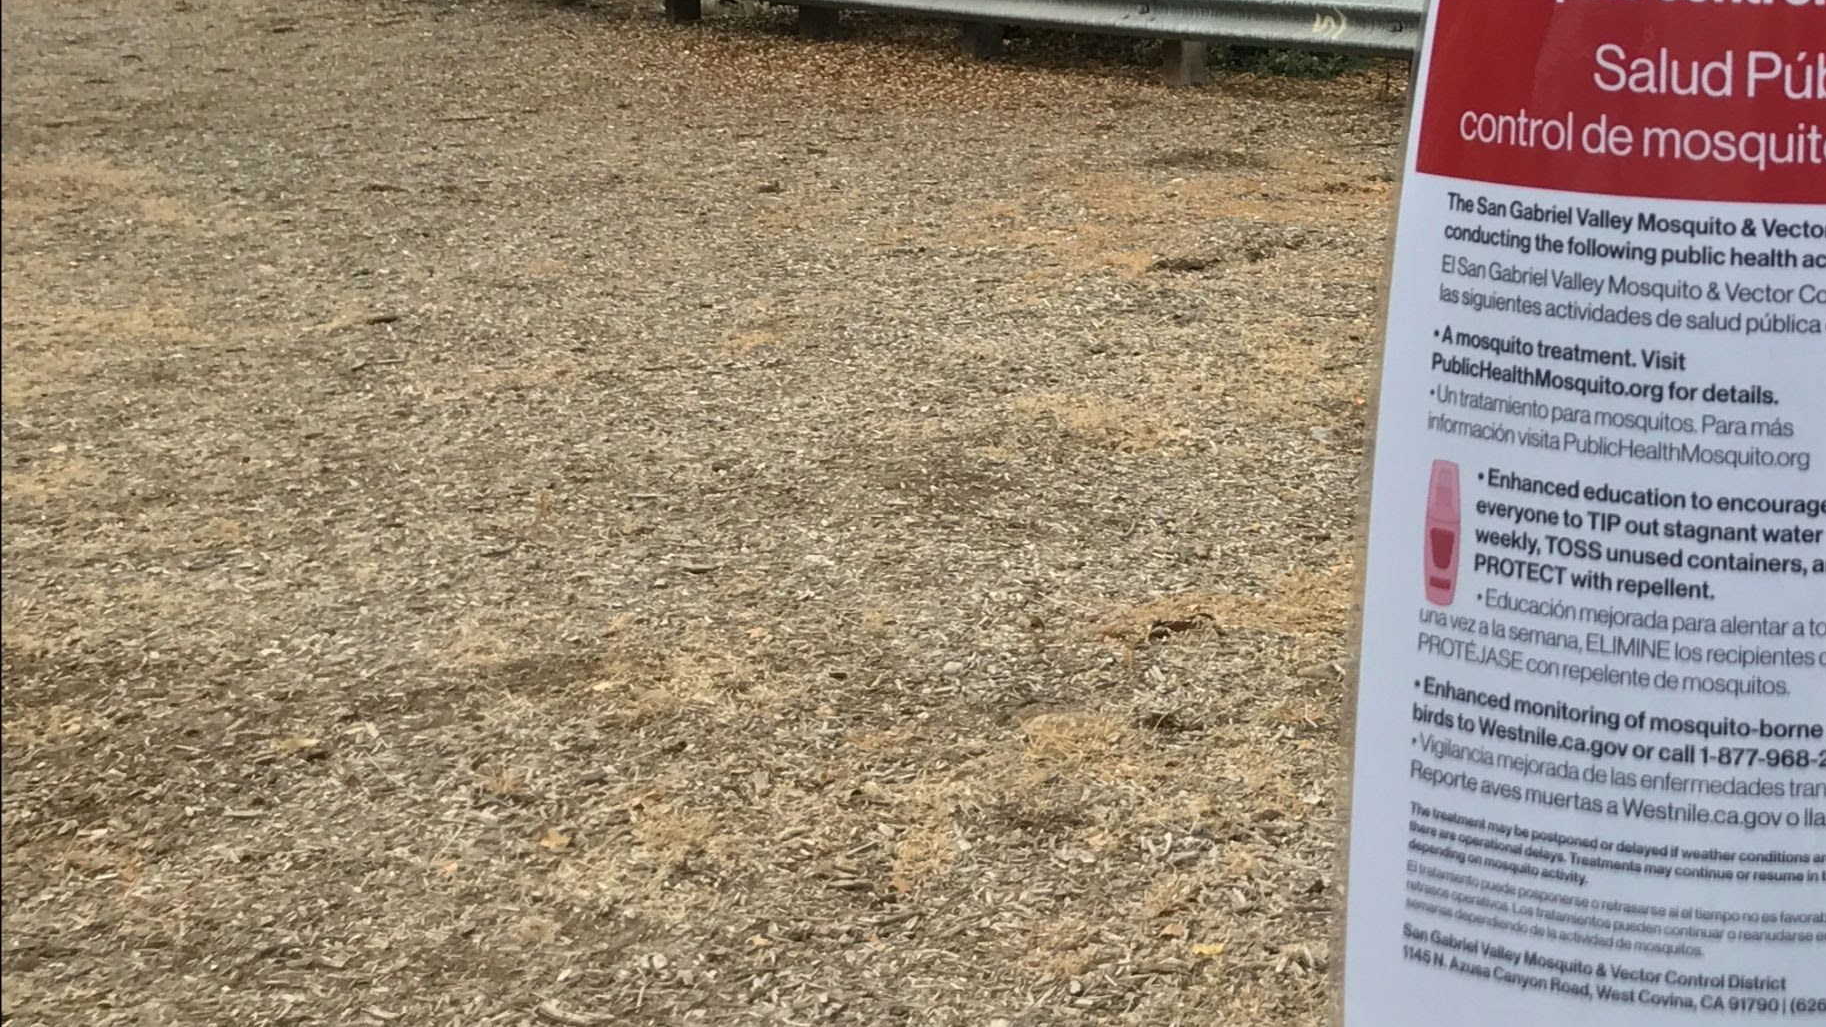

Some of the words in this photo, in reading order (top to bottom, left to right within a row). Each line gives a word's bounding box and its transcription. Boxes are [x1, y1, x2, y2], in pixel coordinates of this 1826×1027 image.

[1594, 44, 1732, 96] Salud
[1461, 109, 1573, 151] control
[1582, 114, 1633, 156] de
[1447, 191, 1474, 213] The
[1476, 195, 1506, 218] San
[1509, 200, 1573, 225] Gabriel
[1576, 206, 1634, 234] Valley
[1637, 212, 1737, 238] Mosquito
[1740, 217, 1757, 237] &
[1444, 224, 1531, 254] conducting
[1534, 232, 1564, 254] the
[1566, 236, 1657, 266] following
[1660, 244, 1726, 267] public
[1730, 246, 1798, 268] health
[1441, 253, 1456, 274] El
[1456, 256, 1486, 279] San
[1488, 261, 1548, 287] Gabriel
[1550, 268, 1605, 297] Valley
[1608, 274, 1703, 302] Mosquito
[1705, 281, 1721, 301] &
[1724, 281, 1795, 304] Vector
[1439, 282, 1460, 305] las
[1461, 288, 1542, 317] siguientes
[1544, 300, 1653, 327] actividades
[1655, 308, 1682, 329] de
[1685, 310, 1742, 332] salud
[1745, 312, 1822, 336] pública
[1441, 324, 1453, 345] A
[1455, 331, 1534, 357] mosquito
[1536, 339, 1636, 368] treatment.
[1640, 348, 1686, 371] Visit
[1431, 351, 1664, 403] PublicHealthMosquito.org
[1668, 380, 1698, 401] for
[1701, 383, 1779, 405] details.
[1436, 383, 1458, 405] Un
[1459, 388, 1549, 420] tratamiento
[1550, 405, 1592, 425] para
[1594, 410, 1698, 434] mosquitos.
[1701, 414, 1748, 437] Para
[1750, 417, 1794, 438] más
[1427, 411, 1515, 444] información
[1517, 427, 1560, 451] visita
[1562, 431, 1810, 472] PublicHealthMosquito.org
[1487, 467, 1580, 499] Enhanced
[1582, 483, 1686, 509] education
[1690, 491, 1713, 511] to
[1476, 499, 1559, 526] everyone
[1562, 509, 1583, 529] to
[1586, 510, 1621, 532] TIP
[1624, 518, 1659, 537] out
[1663, 519, 1758, 544] stagnant
[1762, 524, 1824, 544] water
[1474, 552, 1568, 585] PROTECT
[1570, 569, 1612, 591] with
[1616, 577, 1715, 600] repellent.
[1475, 528, 1541, 556] weekly,
[1544, 534, 1602, 561] TOSS
[1606, 547, 1683, 568] unused
[1686, 552, 1808, 576] containers,
[1412, 701, 1454, 729] birds
[1456, 712, 1475, 733] to
[1478, 716, 1628, 759] Westnile.ca.gov
[1631, 744, 1655, 760] or
[1658, 743, 1695, 764] call
[1423, 675, 1511, 712] Enhanced
[1513, 698, 1620, 731] monitoring
[1623, 710, 1646, 730] of
[1649, 716, 1824, 739] mosquito-borne
[1419, 732, 1495, 767] Vigilancia
[1496, 753, 1580, 781] mejorada
[1582, 763, 1608, 785] de
[1610, 766, 1637, 788] las
[1639, 771, 1786, 798] enfermedades
[1410, 758, 1478, 792] Reporte
[1480, 779, 1522, 801] aves
[1524, 788, 1603, 814] muertas
[1606, 799, 1619, 817] a
[1622, 796, 1782, 830] Westnile.ca.gov
[1785, 811, 1800, 827] o
[1402, 922, 1428, 942] San
[1430, 929, 1479, 955] Gabriel
[1480, 941, 1522, 966] Valley
[1523, 950, 1593, 977] Mosquito
[1594, 962, 1607, 979] &
[1610, 963, 1662, 985] Vector
[1664, 969, 1725, 989] Control
[1727, 974, 1786, 992] District
[1432, 951, 1447, 968] N.
[1448, 956, 1491, 979] Azusa
[1492, 965, 1548, 990] Canyon
[1549, 976, 1593, 1000] Road,
[1596, 983, 1635, 1004] West
[1637, 988, 1698, 1012] Covina,
[1700, 994, 1725, 1011] CA
[1728, 996, 1780, 1013] 91790
